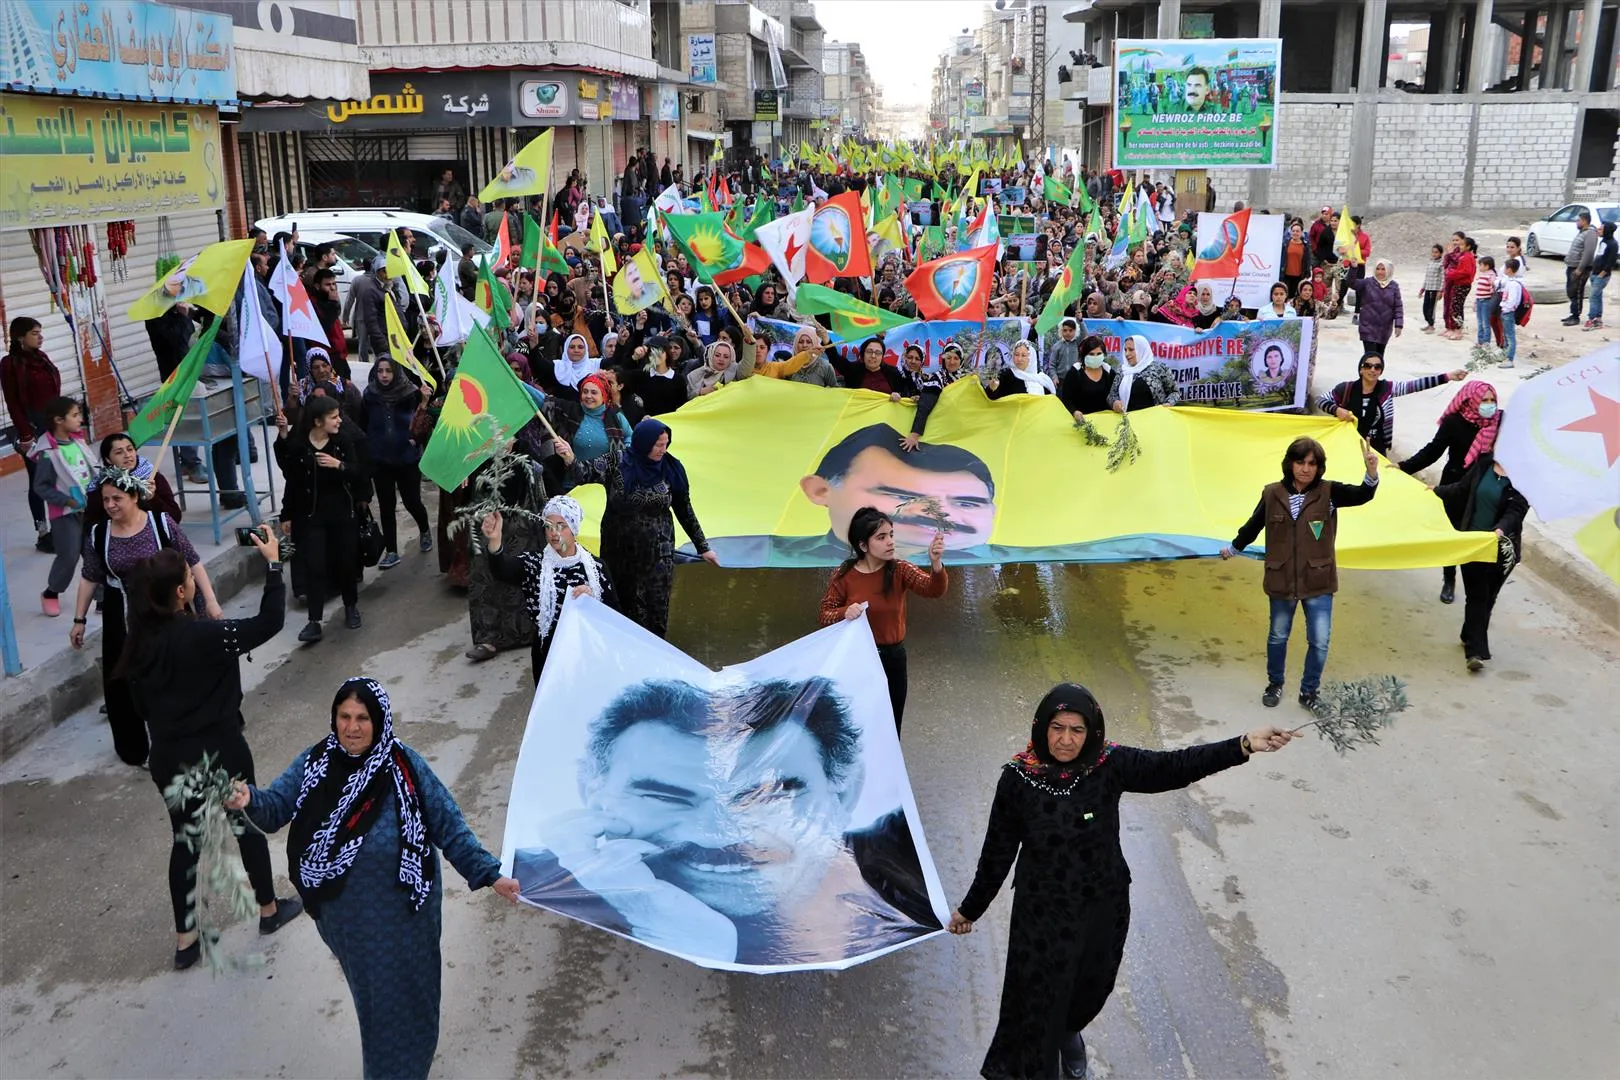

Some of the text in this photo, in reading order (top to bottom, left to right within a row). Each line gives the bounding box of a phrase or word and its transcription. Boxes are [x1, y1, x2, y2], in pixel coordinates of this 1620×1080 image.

[326, 82, 489, 123] شركة شمس
[1151, 113, 1195, 123] NEWROZ
[1228, 112, 1243, 122] BE
[100, 106, 191, 165] كاميران
[1228, 382, 1242, 398] YE
